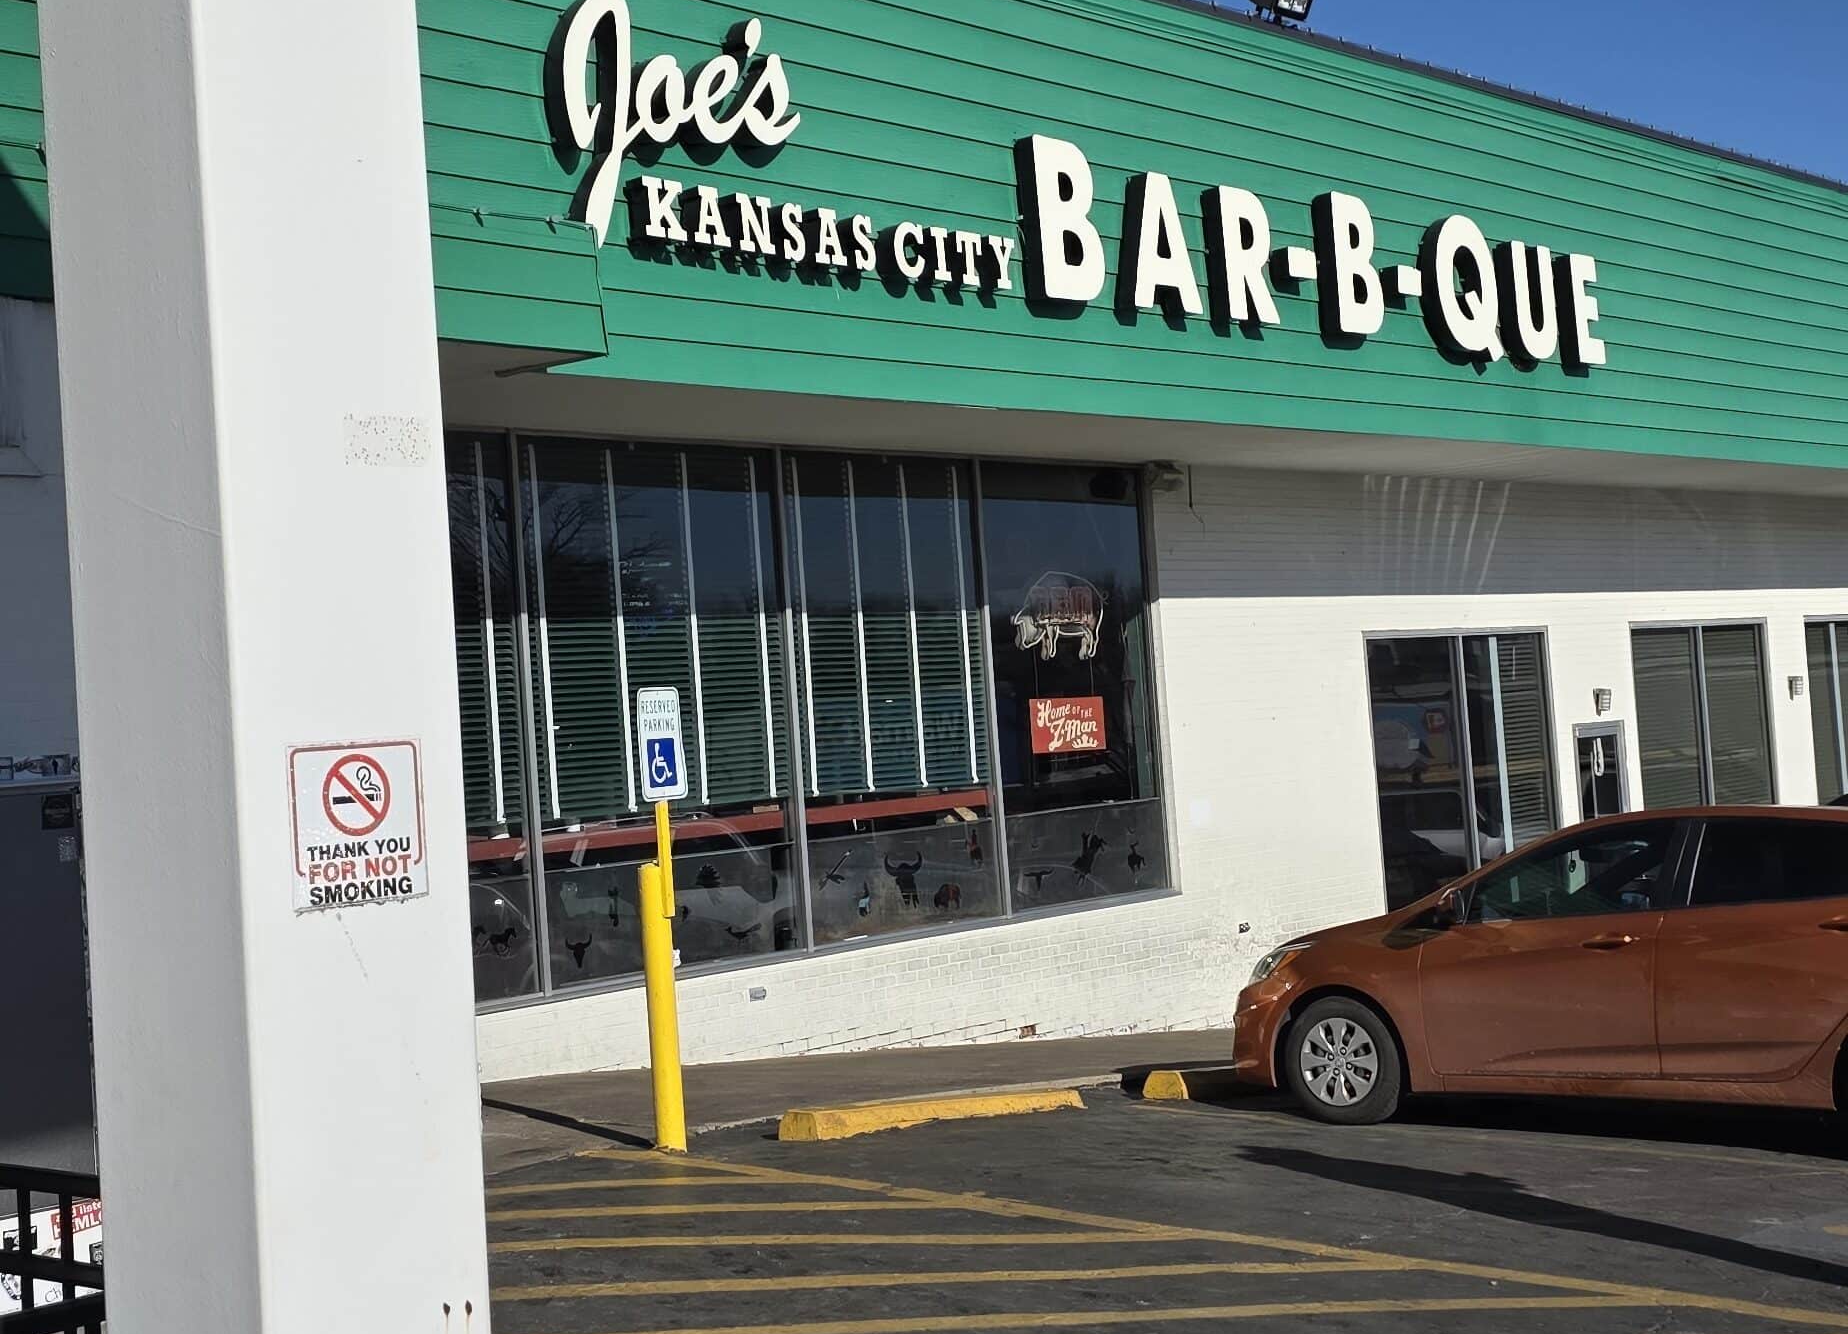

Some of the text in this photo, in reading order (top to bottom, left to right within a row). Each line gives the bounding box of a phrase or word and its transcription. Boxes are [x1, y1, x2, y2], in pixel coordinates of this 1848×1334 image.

[641, 133, 1607, 366] KANSAS CITY BAR-B-QUE
[640, 699, 676, 714] RESERVED
[1036, 699, 1071, 727] Home
[643, 717, 675, 732] PARKING
[306, 836, 411, 862] THANK YOU
[308, 854, 412, 884] FOR NOT
[309, 876, 413, 906] SMOKING
